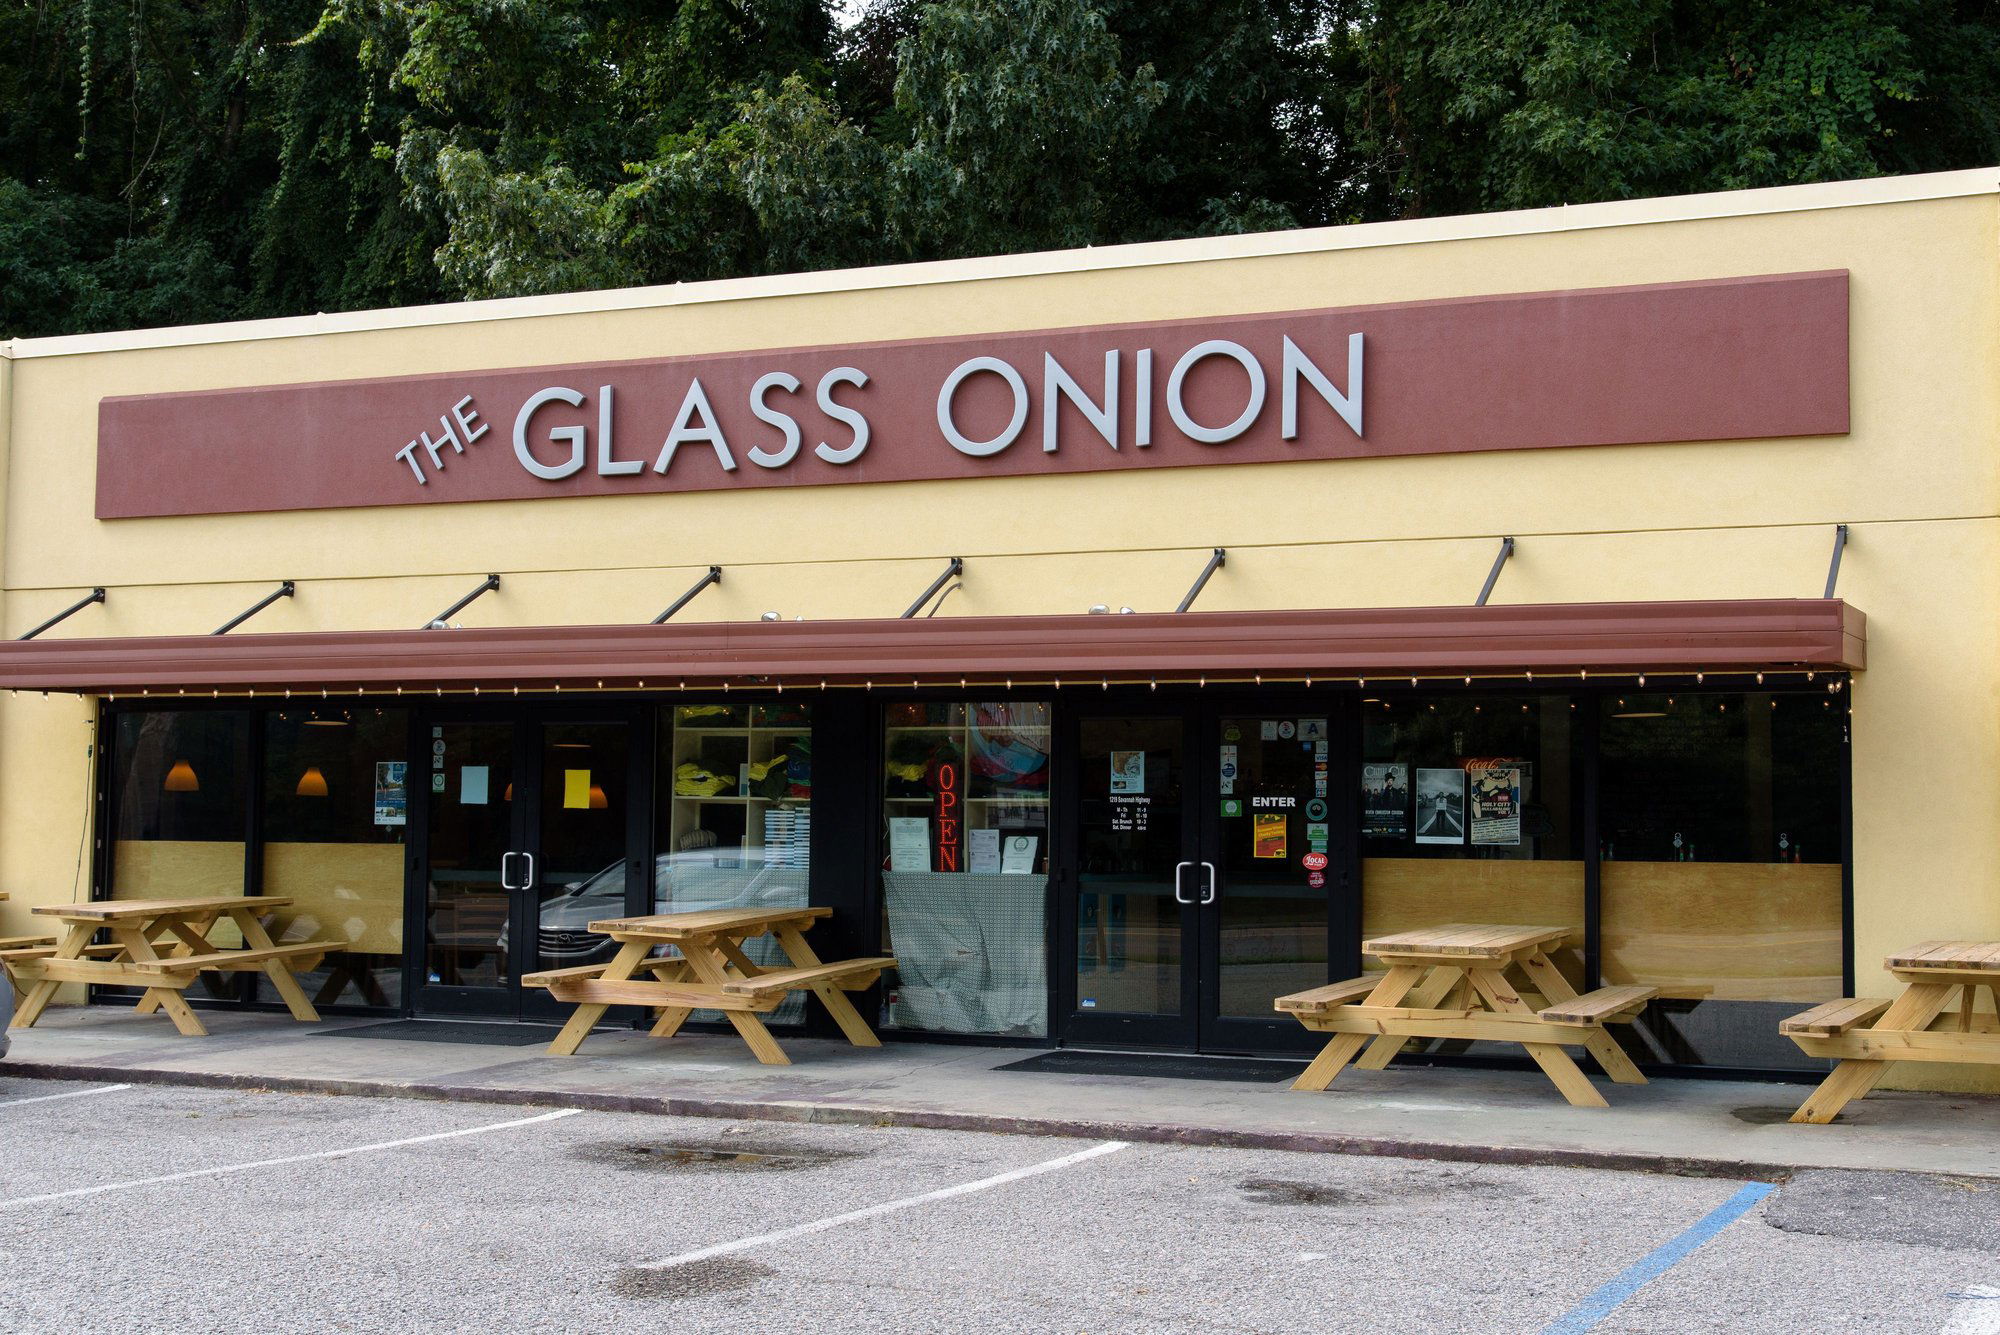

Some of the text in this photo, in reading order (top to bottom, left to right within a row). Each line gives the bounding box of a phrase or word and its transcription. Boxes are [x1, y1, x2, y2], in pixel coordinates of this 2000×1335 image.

[395, 332, 1365, 486] THE GLASS ONION
[1307, 723, 1319, 734] A
[1252, 797, 1296, 807] ENTER
[939, 764, 957, 872] OPEN
[1305, 856, 1325, 866] LOCAL
